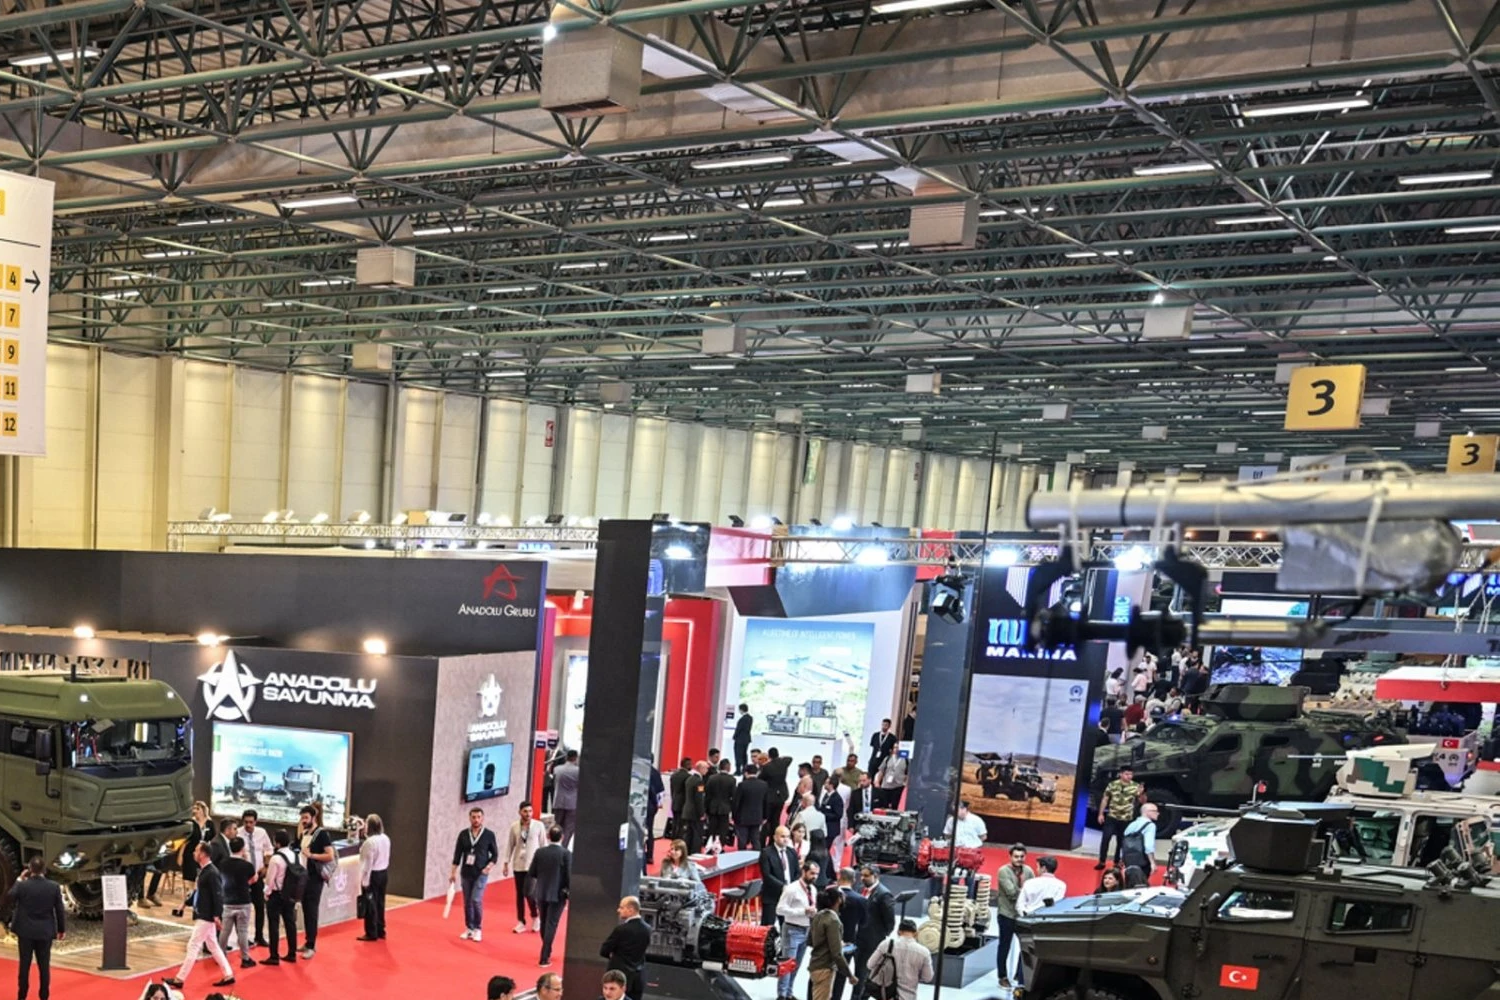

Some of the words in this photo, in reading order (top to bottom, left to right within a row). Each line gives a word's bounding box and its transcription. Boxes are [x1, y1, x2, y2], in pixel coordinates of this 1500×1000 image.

[9, 271, 17, 286] 4
[9, 308, 16, 322] 7
[8, 345, 15, 359] 9
[5, 381, 16, 396] 11
[1307, 379, 1336, 416] 3
[4, 417, 16, 432] 12
[1461, 443, 1480, 466] 3
[458, 603, 502, 616] ANADOLU
[504, 604, 536, 617] GRUBU
[263, 672, 377, 694] ANADOLU
[262, 687, 376, 709] SAVUNMA
